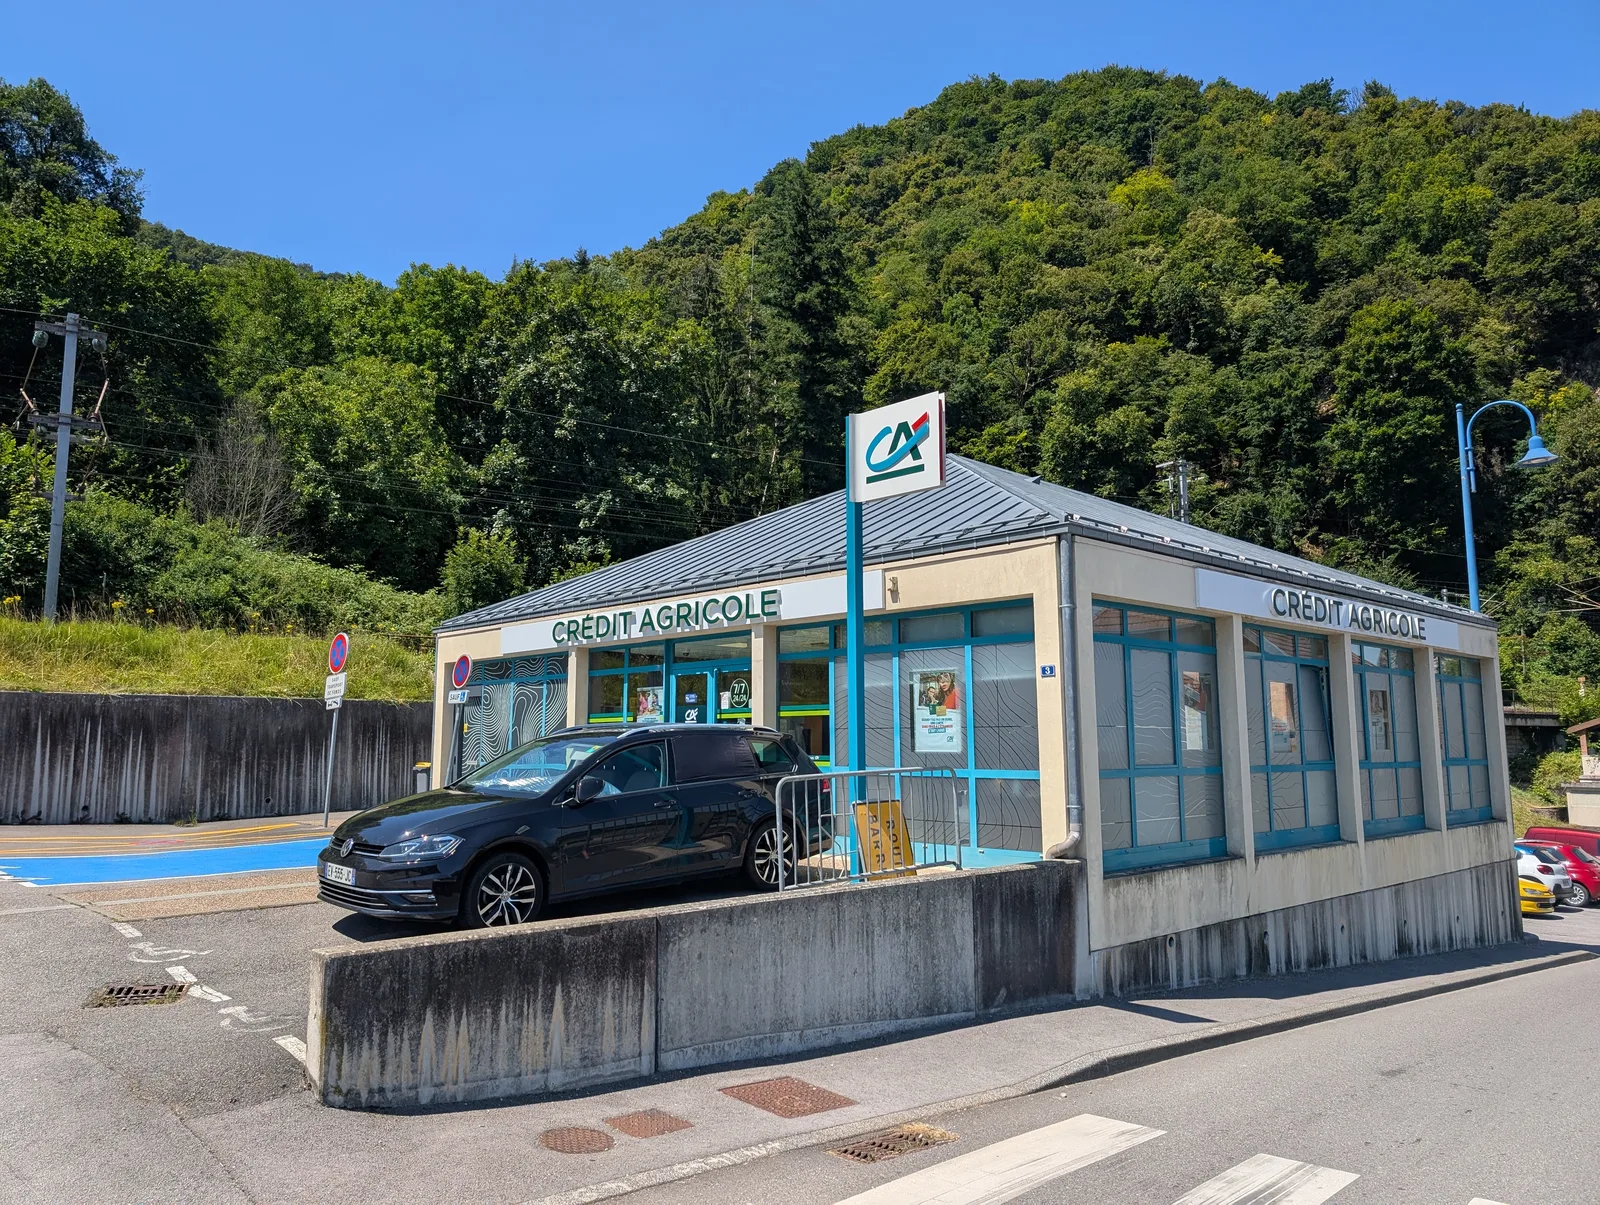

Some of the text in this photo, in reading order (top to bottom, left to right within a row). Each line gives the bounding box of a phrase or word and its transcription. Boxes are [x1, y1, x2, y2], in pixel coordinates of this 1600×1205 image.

[552, 589, 778, 644] CRÉDIT AGRICOLE
[1273, 588, 1427, 641] CRÉDIT AGRICOLE
[732, 694, 747, 702] 24/24
[733, 683, 745, 694] 7/7
